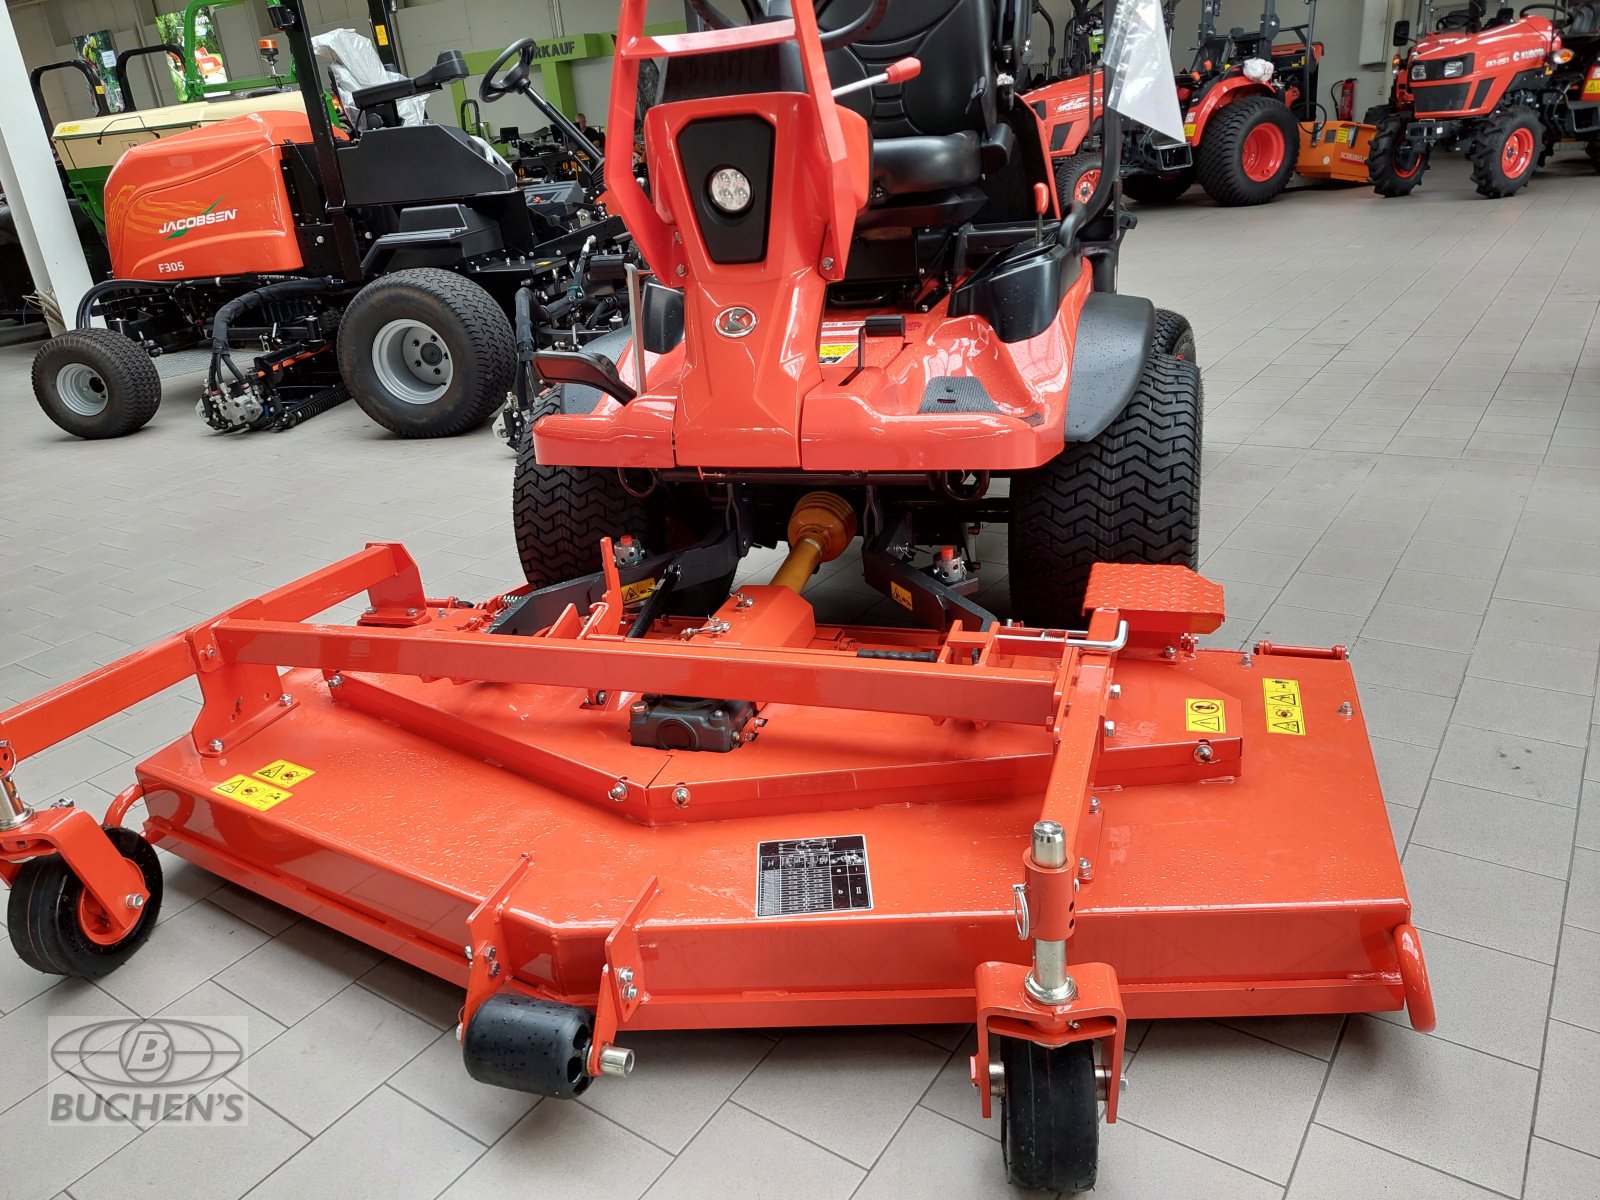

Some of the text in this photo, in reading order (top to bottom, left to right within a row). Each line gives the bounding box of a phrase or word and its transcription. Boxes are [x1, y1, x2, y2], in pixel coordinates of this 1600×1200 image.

[534, 41, 575, 59] RKAUF
[159, 209, 237, 234] JACOBSEN
[158, 261, 185, 274] F305
